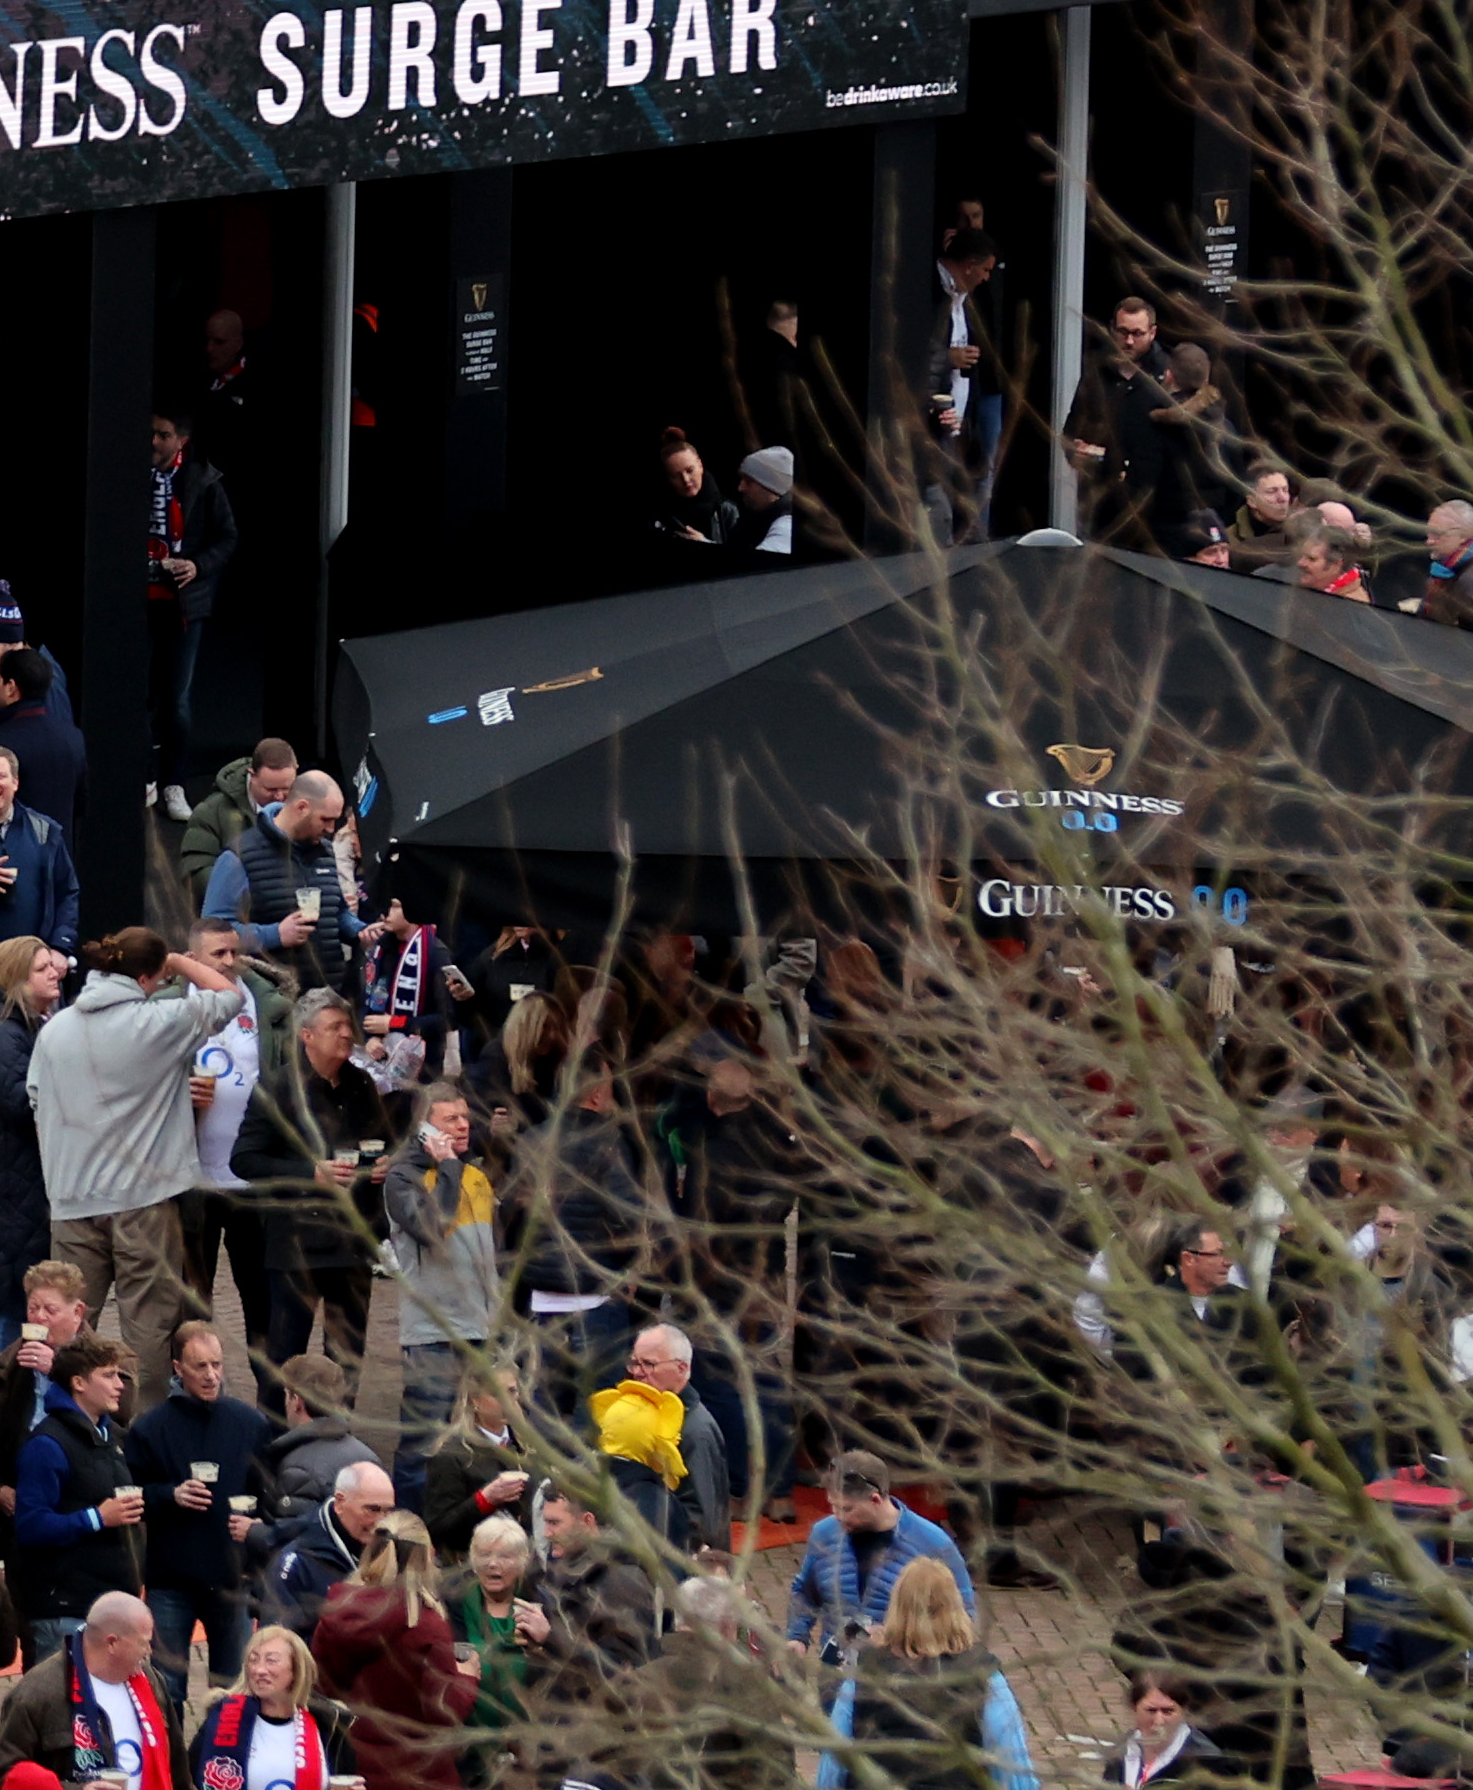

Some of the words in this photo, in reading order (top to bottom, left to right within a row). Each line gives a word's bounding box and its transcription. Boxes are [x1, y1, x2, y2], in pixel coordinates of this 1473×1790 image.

[825, 76, 958, 108] bedrinkaware.co.uk
[986, 790, 1184, 815] GUINNESS
[1062, 810, 1118, 833] 0.0
[979, 879, 1176, 920] GUINESS
[1192, 885, 1248, 926] 00
